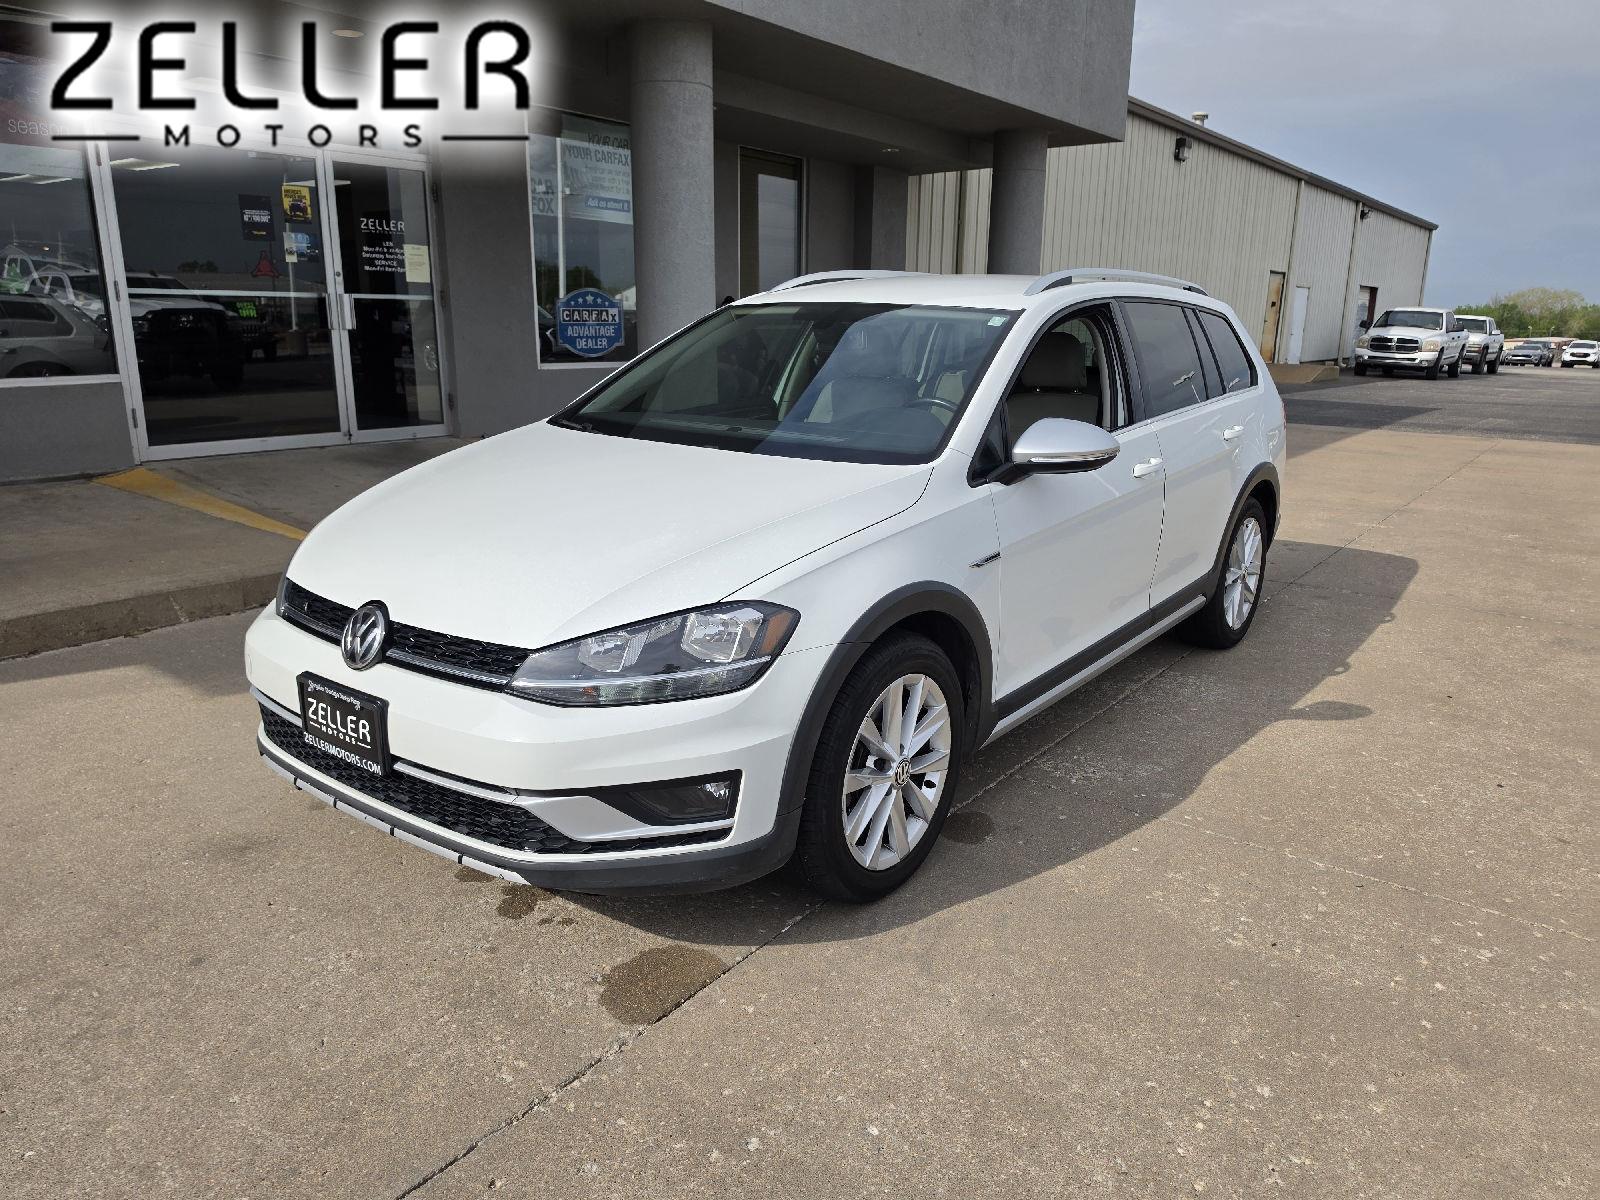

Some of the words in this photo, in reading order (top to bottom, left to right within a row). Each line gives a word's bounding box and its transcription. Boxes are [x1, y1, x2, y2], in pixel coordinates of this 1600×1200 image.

[565, 145, 592, 161] YOUR
[595, 150, 630, 167] CARFAX
[360, 218, 405, 231] ZELLER
[561, 308, 618, 323] CARFAX
[567, 326, 615, 337] ADVANTAGE
[576, 338, 608, 349] DEALER
[307, 697, 371, 743] ZELLER
[321, 725, 356, 745] MOTORS
[303, 731, 382, 776] ZELLERMOTORS.COM
